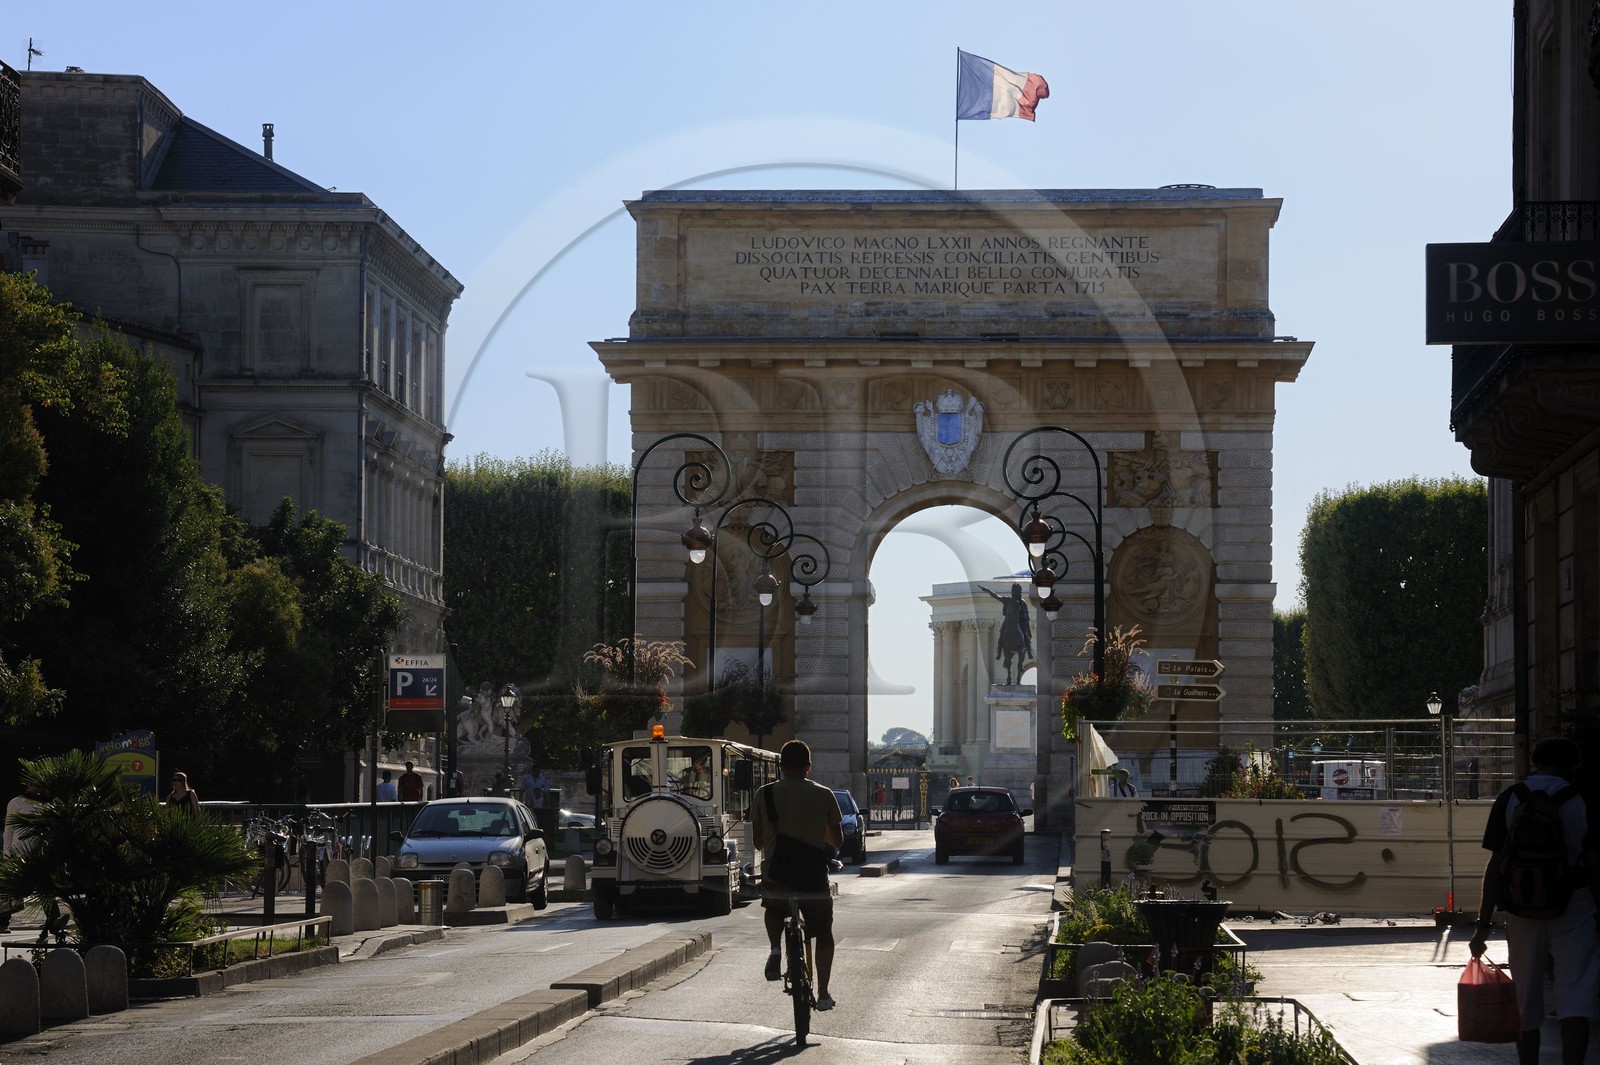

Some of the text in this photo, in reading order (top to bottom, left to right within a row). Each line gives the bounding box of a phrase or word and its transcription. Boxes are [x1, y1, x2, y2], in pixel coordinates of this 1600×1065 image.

[751, 236, 1149, 249] LUDOVICO MAGNO LXXII ANNOS REGNANTE
[736, 251, 1160, 264] DISSOCIATIS REPRESSIS CONCILIATIS GENTIBUS
[760, 266, 1141, 282] QUATUOR DECENNALI BELLO CONJURATIS
[1446, 259, 1598, 303] BOSS
[801, 281, 1105, 297] PAX TERRA MARIQUE PARTA 1715
[1446, 309, 1598, 322] HUGO BOSS
[1173, 664, 1208, 673] Le Palais
[396, 671, 414, 696] P
[1173, 688, 1208, 696] Le Guilhem
[134, 762, 140, 770] 7
[1142, 811, 1209, 822] ROCK IN OPPOSITION
